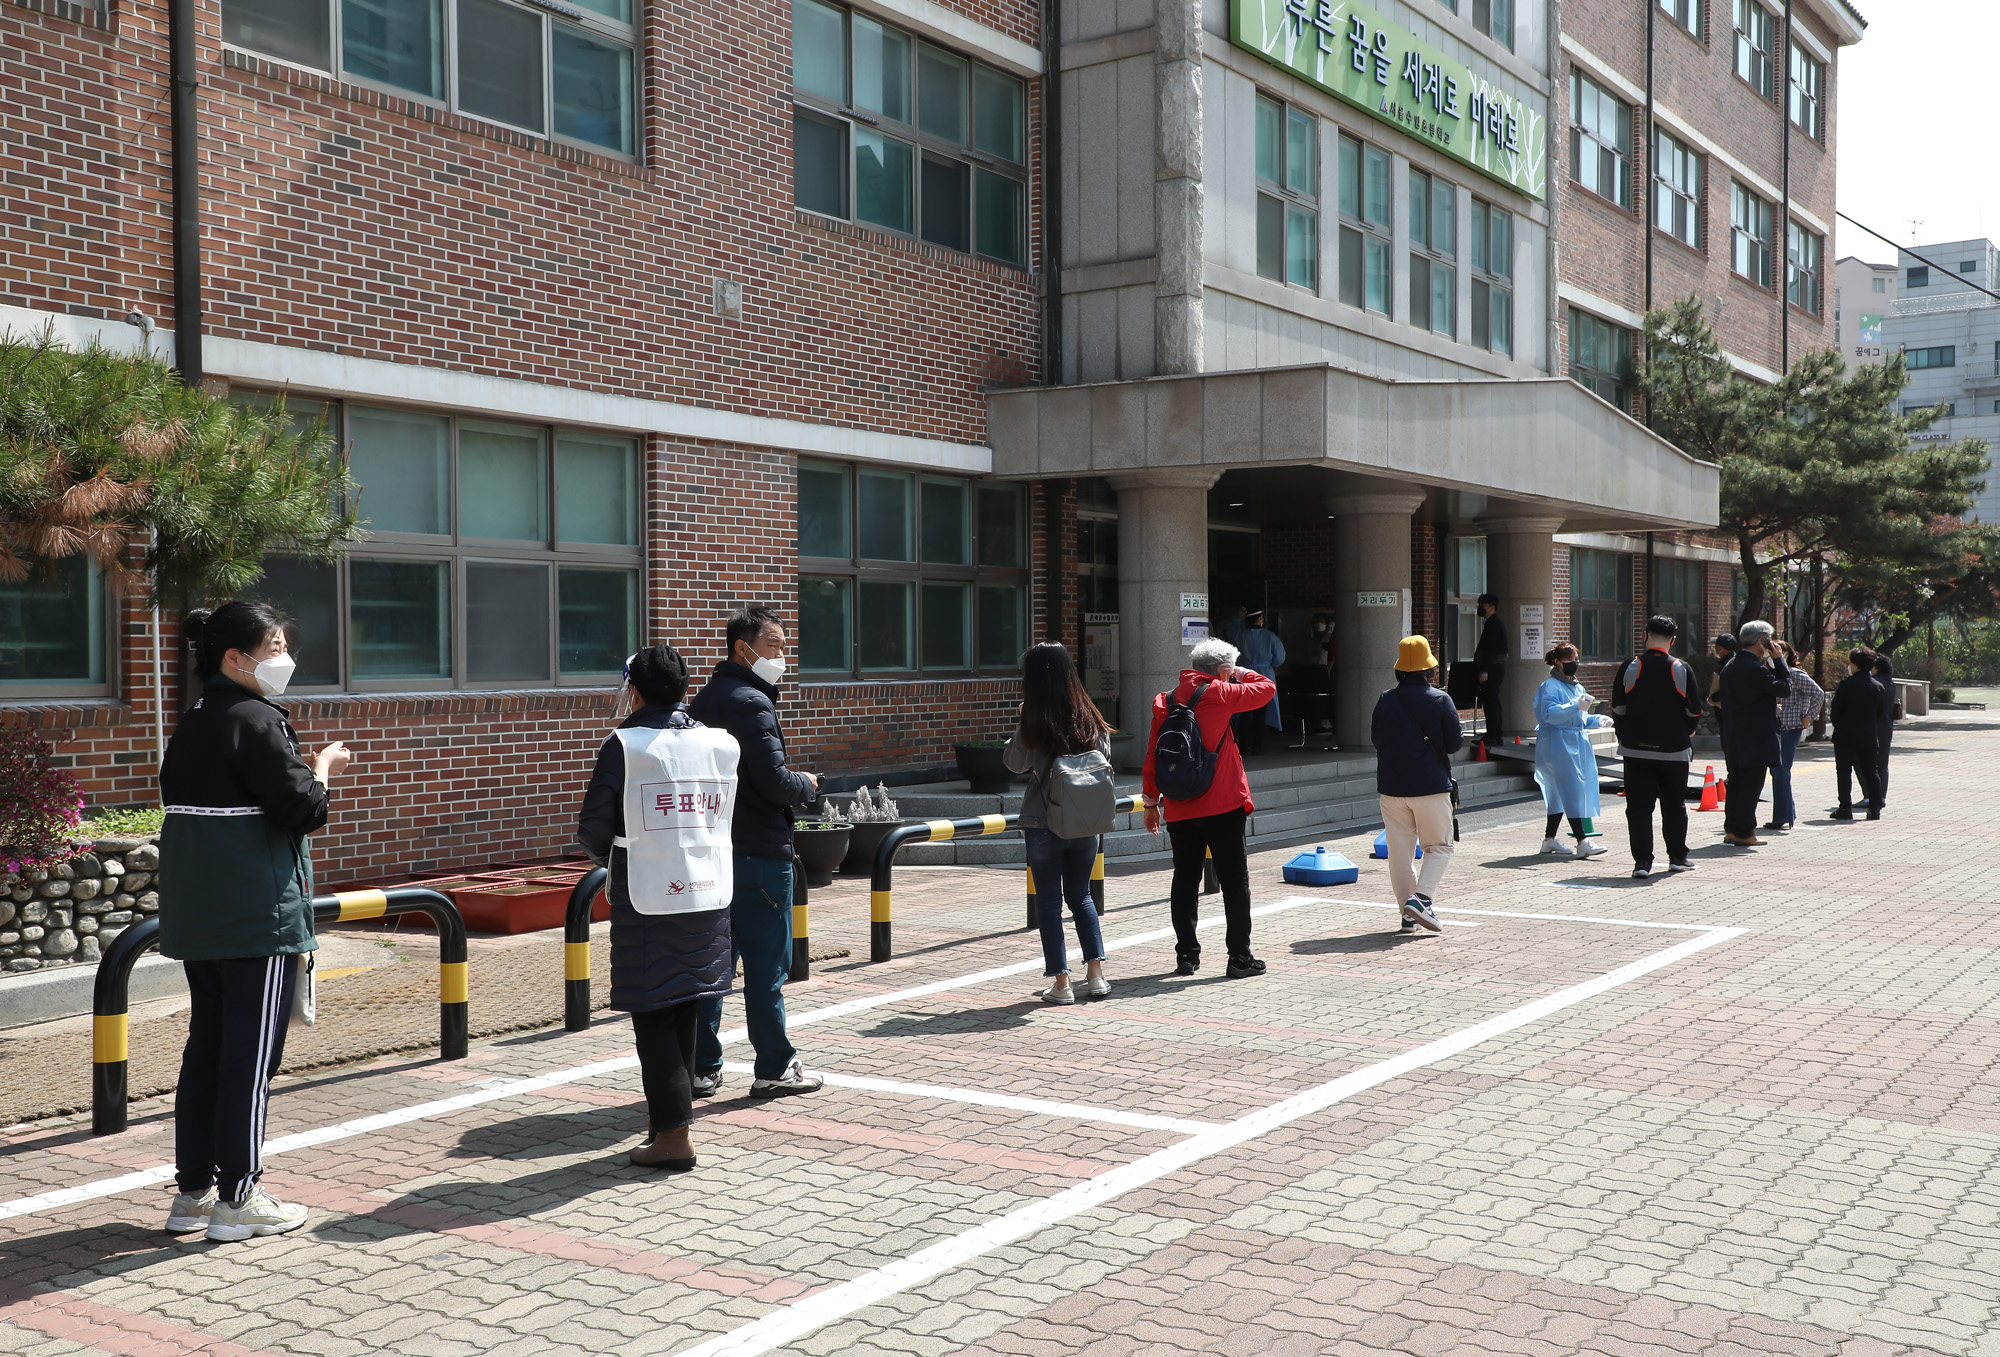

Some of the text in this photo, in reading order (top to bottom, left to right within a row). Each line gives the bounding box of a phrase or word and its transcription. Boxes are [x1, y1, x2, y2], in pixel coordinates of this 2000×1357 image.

[1347, 14, 1392, 86] 꿈을
[1402, 51, 1462, 120] 세계로
[1470, 92, 1521, 154] 미래로
[1360, 596, 1396, 605] 거리두기
[654, 792, 721, 816] 투표안내
